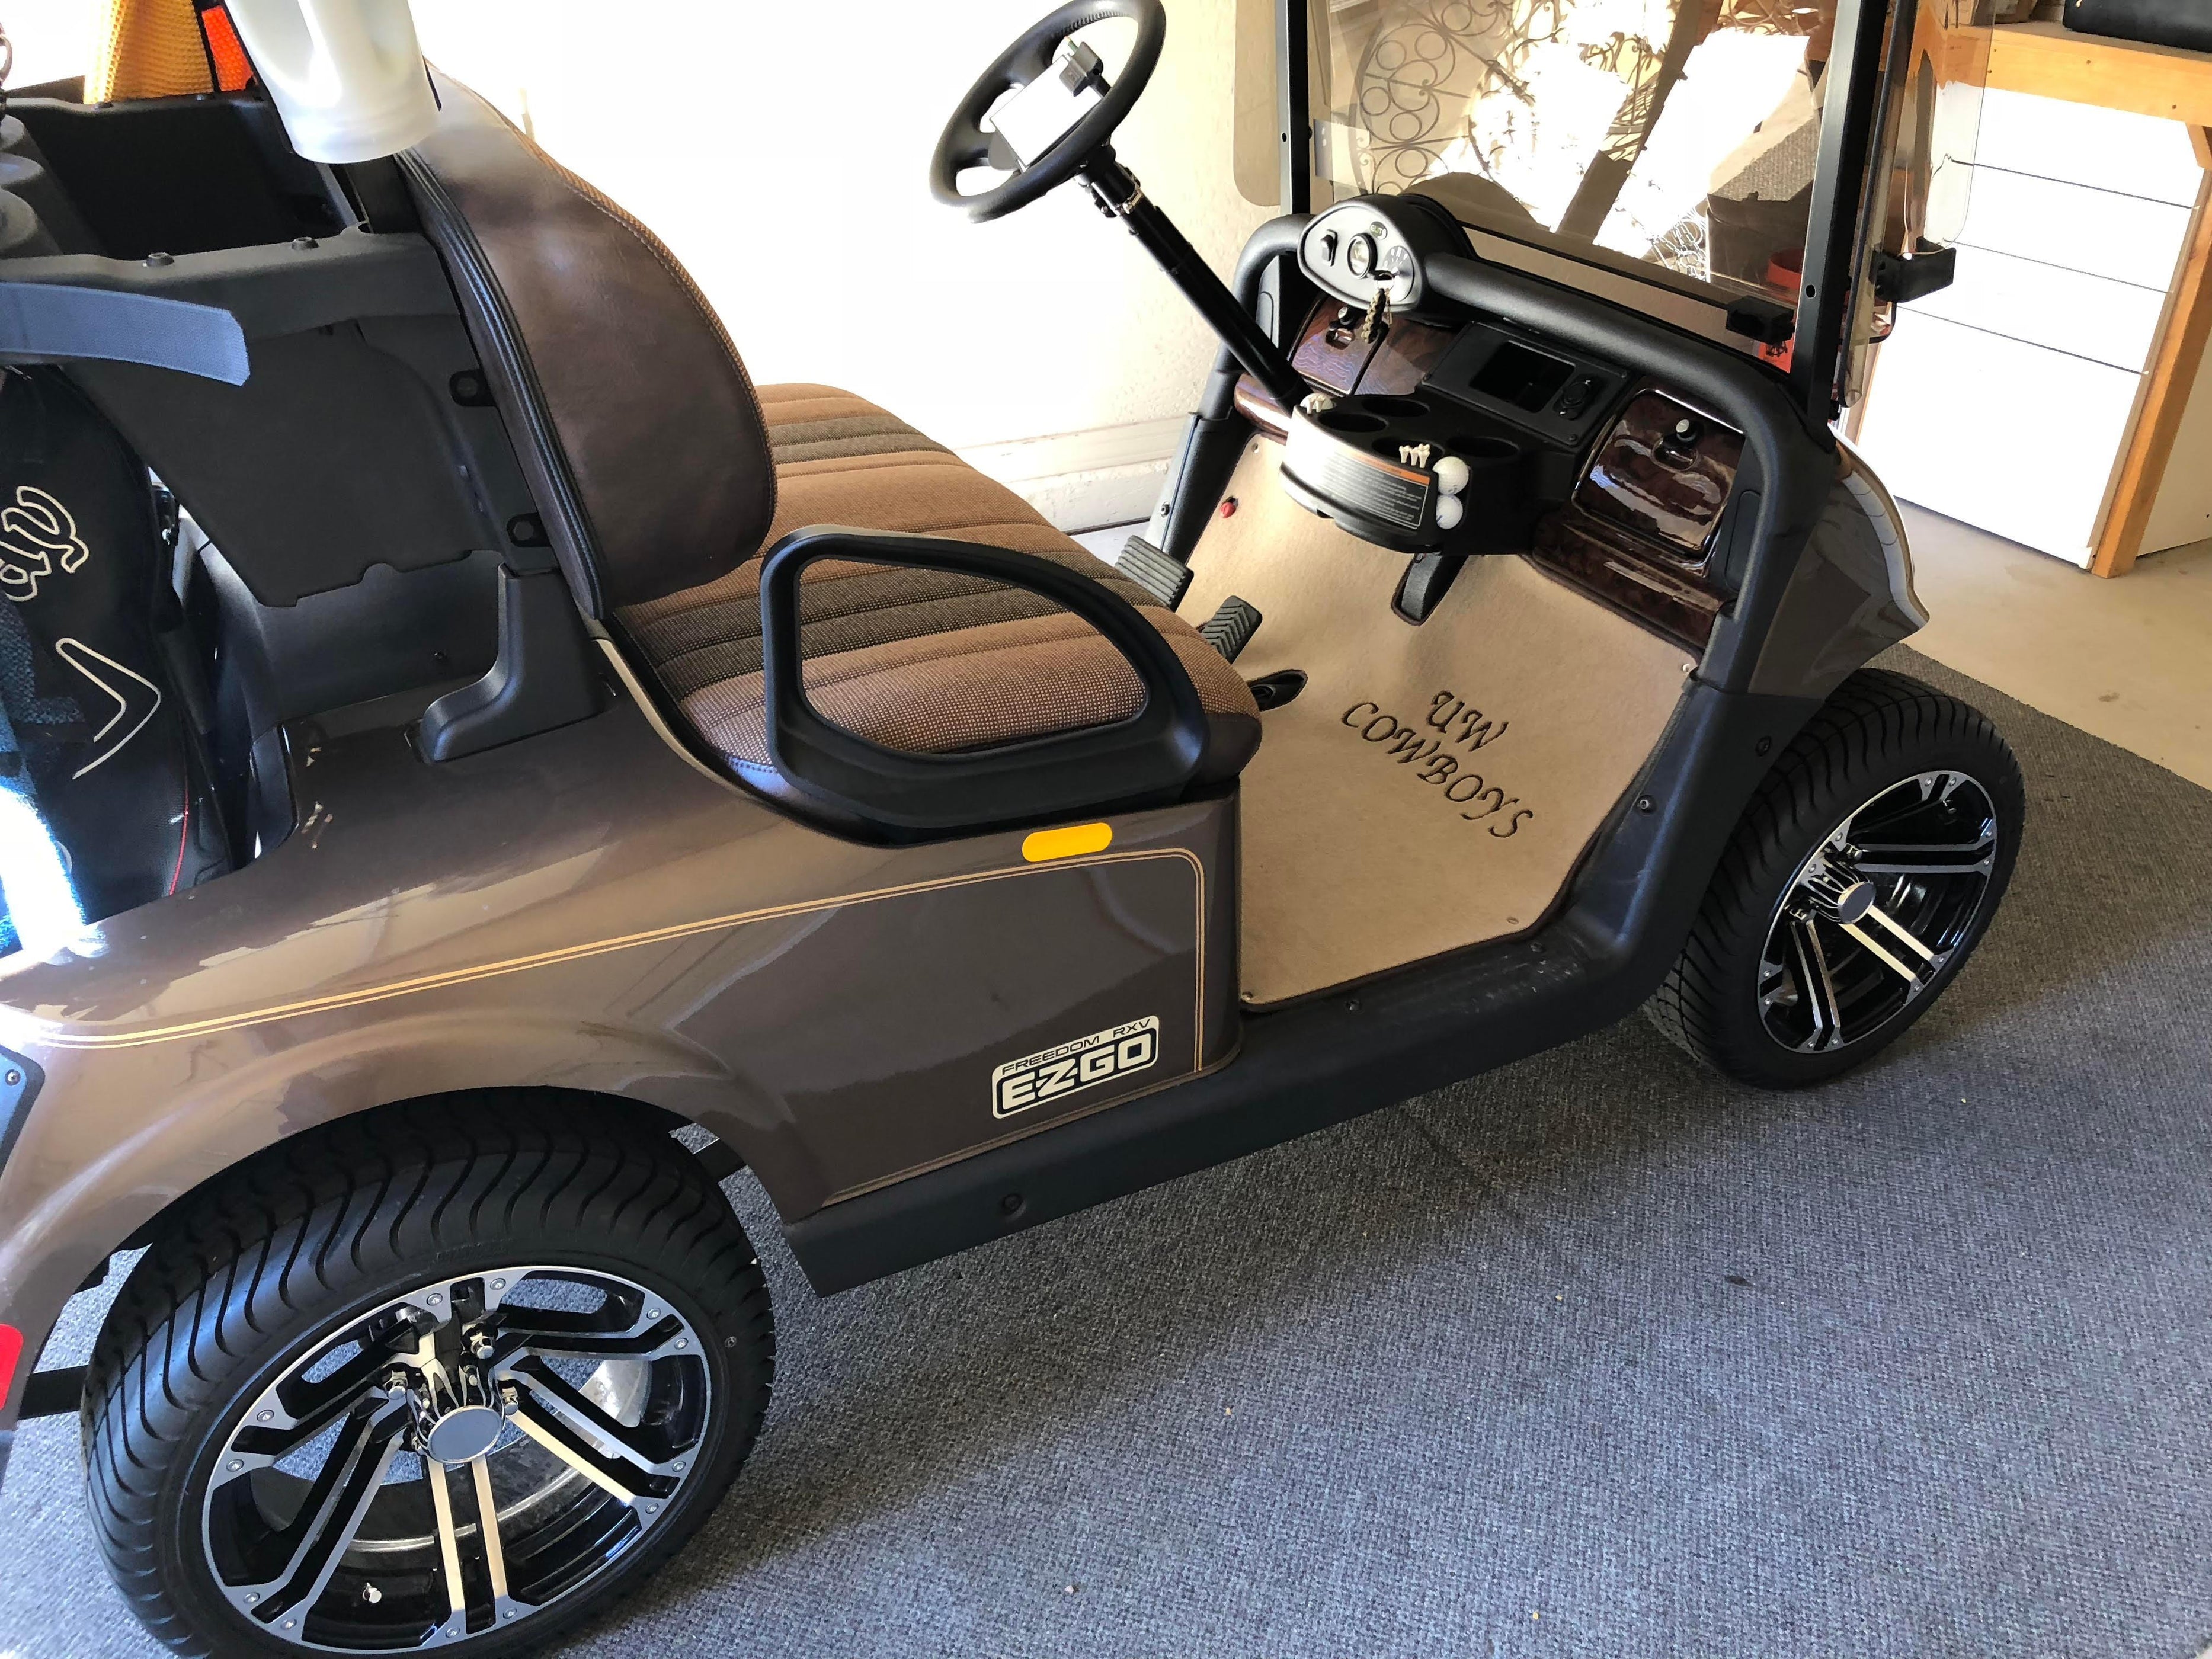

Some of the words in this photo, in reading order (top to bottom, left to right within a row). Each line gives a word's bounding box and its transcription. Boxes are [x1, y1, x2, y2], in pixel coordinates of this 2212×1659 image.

[1426, 690, 1509, 752] UW
[1341, 702, 1534, 838] COWBOYS
[1002, 1035, 1100, 1075] FREEDOM
[1113, 1019, 1151, 1038] RXV
